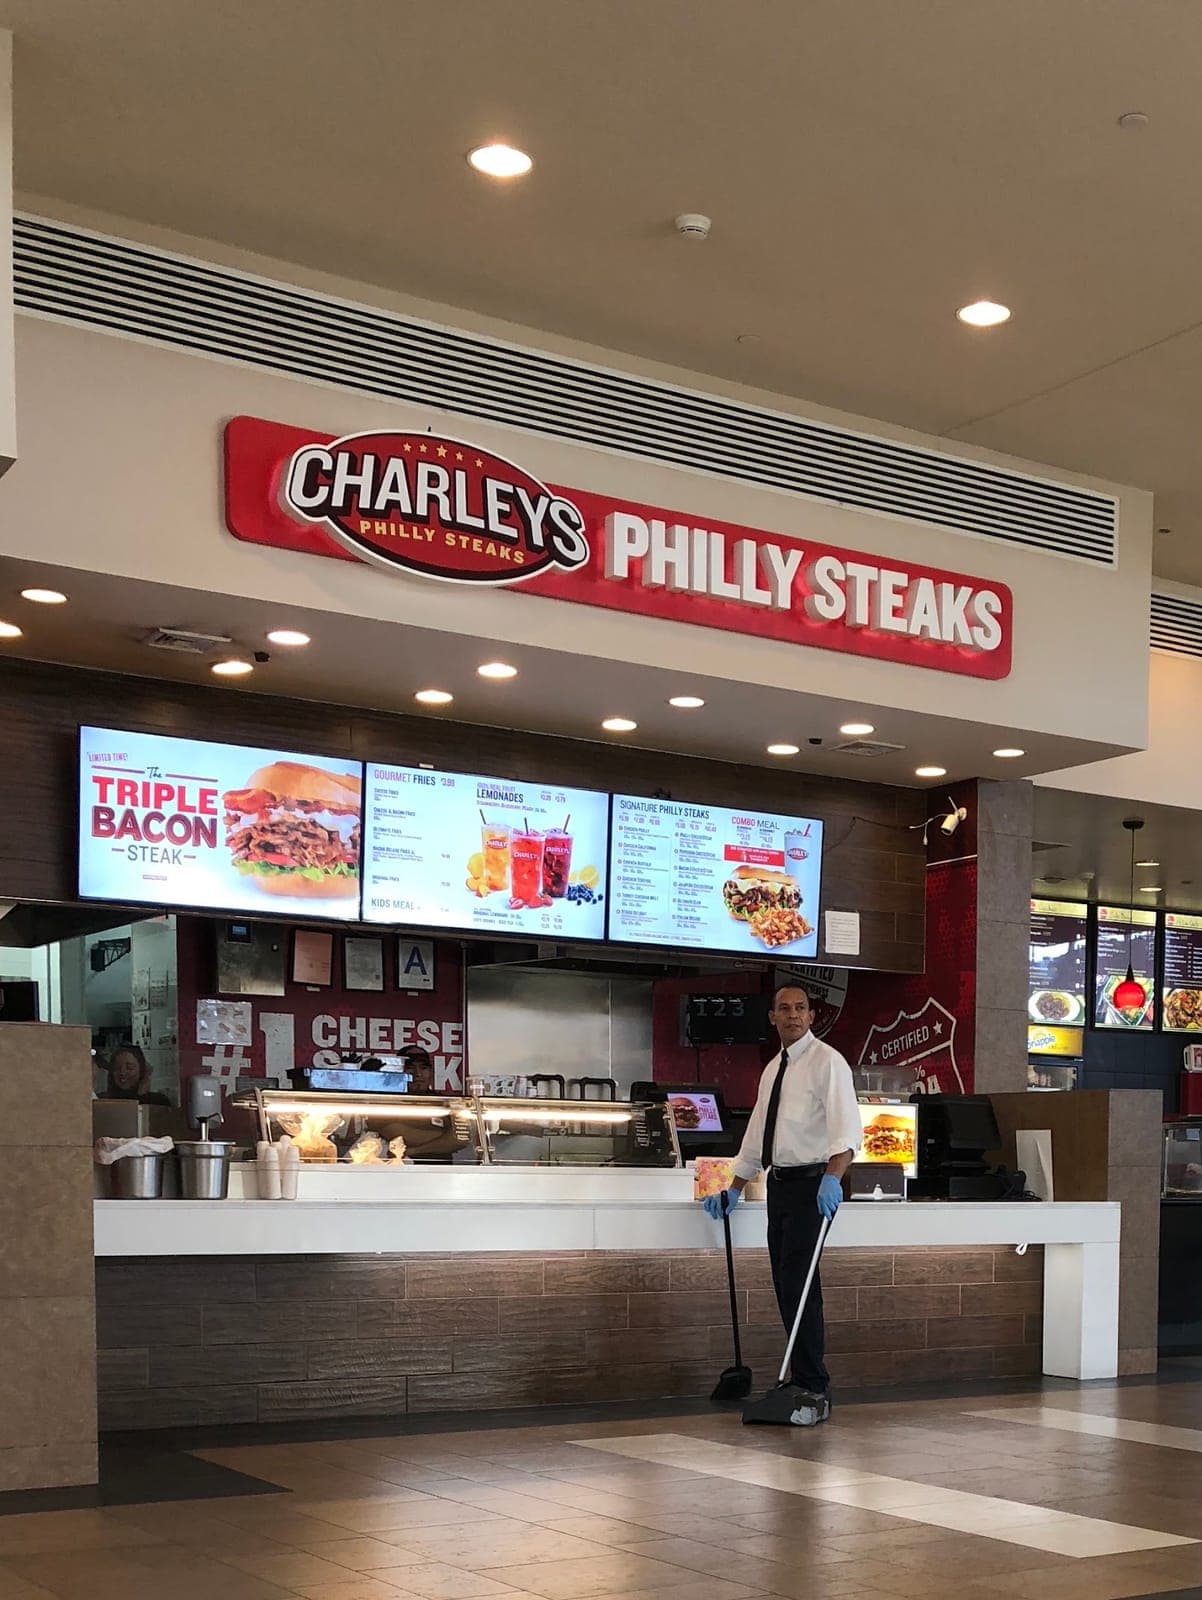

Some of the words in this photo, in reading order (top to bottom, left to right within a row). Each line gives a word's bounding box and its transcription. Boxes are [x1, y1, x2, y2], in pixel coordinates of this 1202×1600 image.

[289, 447, 588, 566] CHARLEYS
[359, 520, 437, 543] PHILLY
[444, 532, 526, 565] STEAKS
[605, 511, 804, 611] PHILLY
[808, 555, 1002, 651] STEAKS
[147, 766, 163, 779] The
[374, 769, 411, 783] GOURMET
[413, 774, 436, 786] FRIES
[92, 775, 218, 816] TRIPLE
[476, 788, 524, 803] LEMONADES
[620, 800, 659, 814] SIGNATURE
[659, 805, 683, 816] PHILLY
[684, 808, 710, 819] STEAKS
[91, 805, 218, 849] BACON
[731, 816, 756, 827] COMBO
[757, 820, 780, 830] MEAL
[127, 845, 182, 865] STEAK
[371, 898, 391, 908] KIDS
[393, 900, 414, 910] MEAL
[403, 946, 428, 975] A
[312, 1015, 463, 1053] CHEESE
[881, 1026, 930, 1059] CERTIFIED
